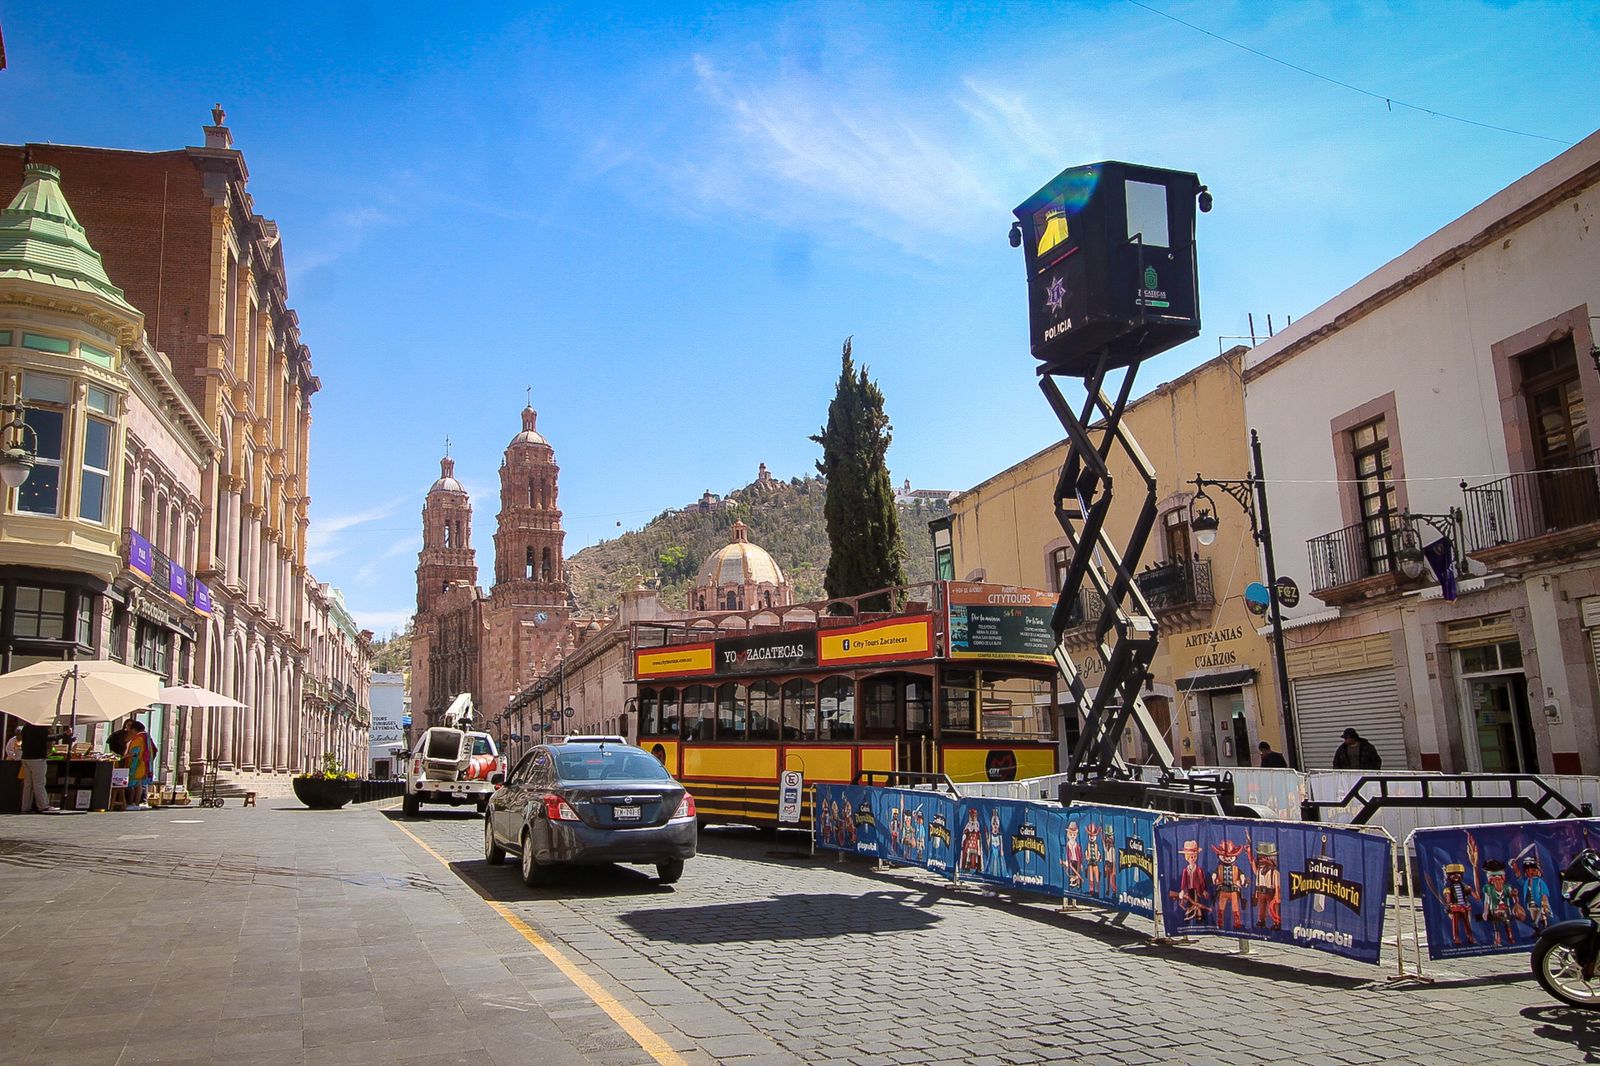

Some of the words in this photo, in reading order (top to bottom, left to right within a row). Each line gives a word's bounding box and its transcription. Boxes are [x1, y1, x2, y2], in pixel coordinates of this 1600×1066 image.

[1138, 289, 1166, 297] ZCATECAS
[1044, 318, 1072, 341] POLICIA
[988, 593, 1031, 604] CITYTOURS
[865, 639, 879, 647] Tours
[880, 636, 908, 645] Zacatecas
[1185, 625, 1243, 648] ARTESANIAS
[724, 651, 737, 663] YO
[747, 644, 804, 661] ZACATECAS
[1211, 644, 1217, 652] Y
[1194, 651, 1236, 668] CUARZOS
[1309, 861, 1339, 878] Galería
[1013, 874, 1044, 886] playmobil
[1290, 872, 1360, 908] PlamoHistoria
